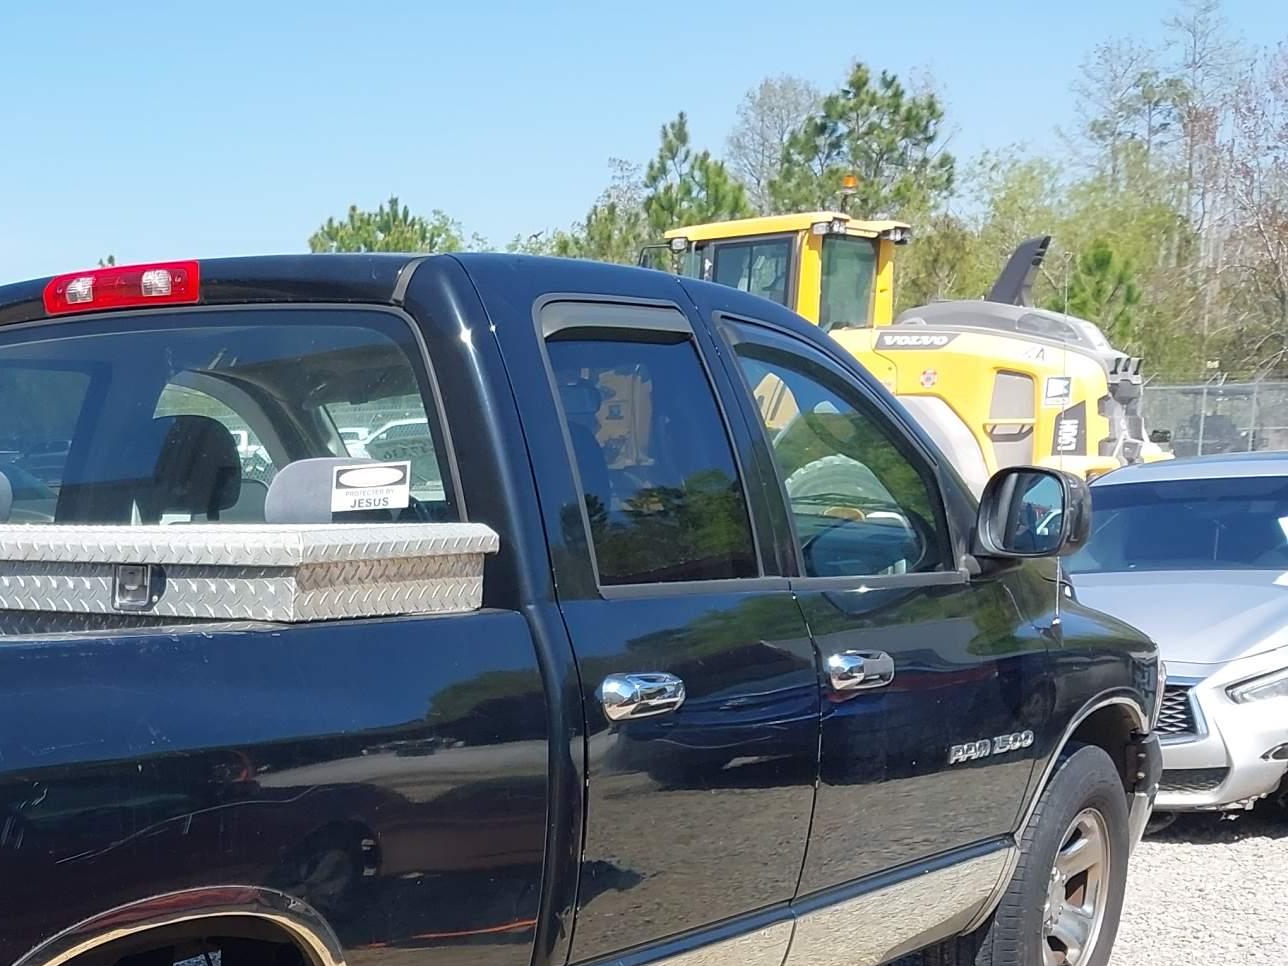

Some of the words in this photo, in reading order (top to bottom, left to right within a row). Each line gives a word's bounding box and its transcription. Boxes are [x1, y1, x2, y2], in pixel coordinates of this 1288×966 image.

[883, 335, 949, 346] VOLVO
[350, 497, 390, 509] JESUS
[949, 739, 992, 765] RAM
[993, 730, 1035, 755] 1500
